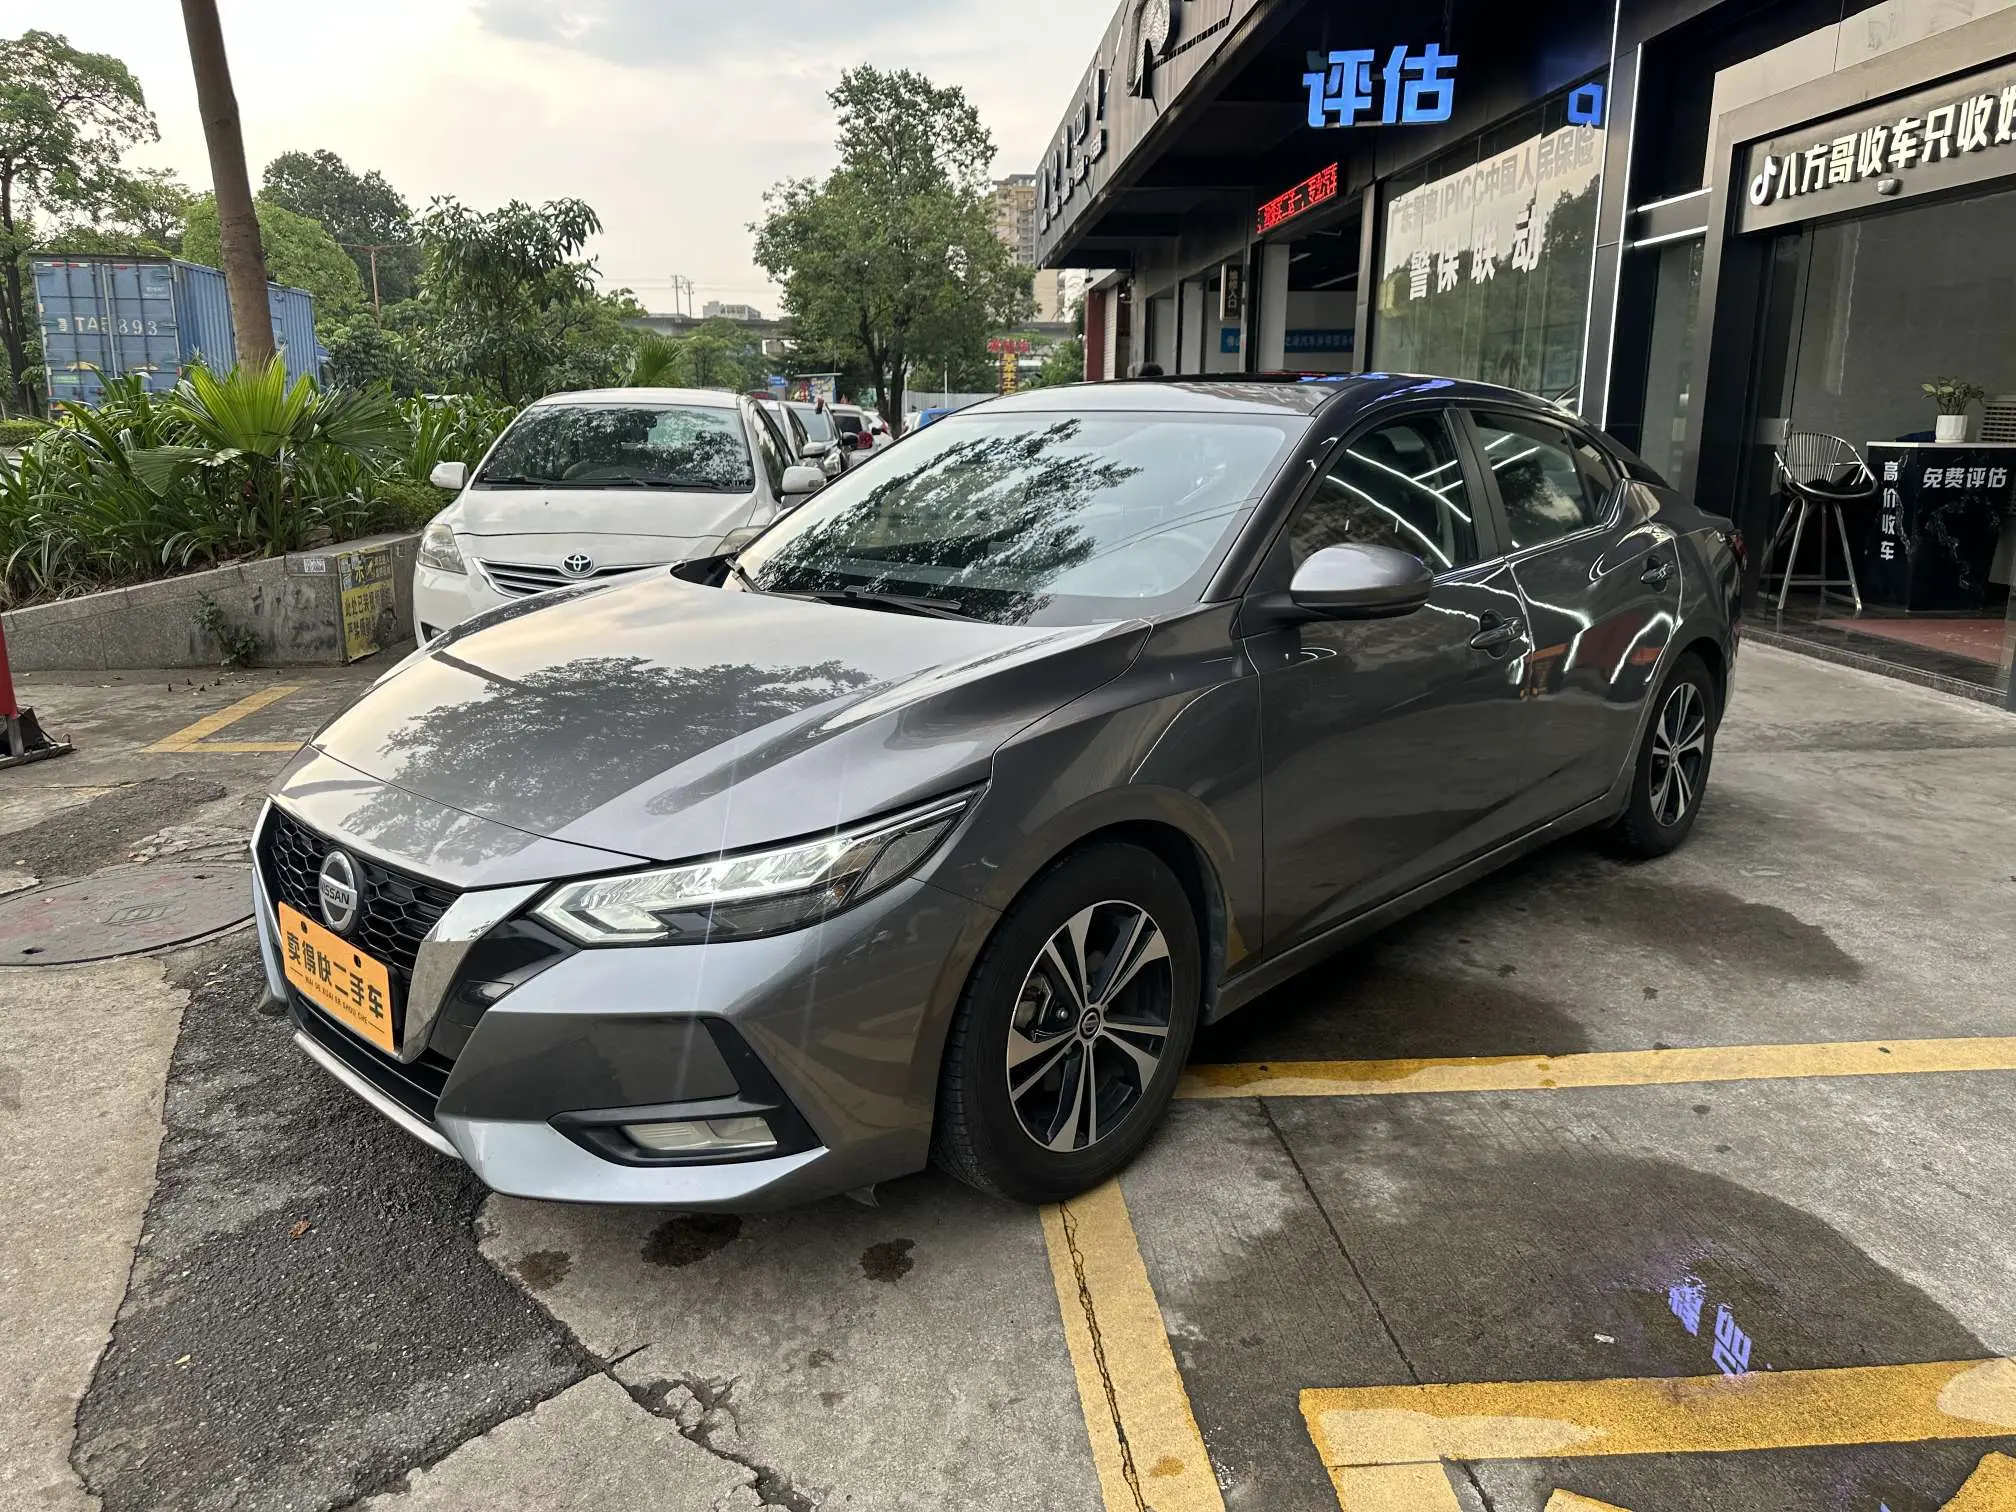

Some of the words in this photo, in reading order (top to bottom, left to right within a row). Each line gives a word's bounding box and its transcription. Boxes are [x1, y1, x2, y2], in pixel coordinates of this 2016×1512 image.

[1303, 43, 1458, 127] 评估
[1409, 204, 1546, 301] 警保联动
[1880, 461, 1899, 561] 高价收车
[1922, 467, 2008, 489] 免费评估
[287, 930, 384, 1019] 卖得快二手车
